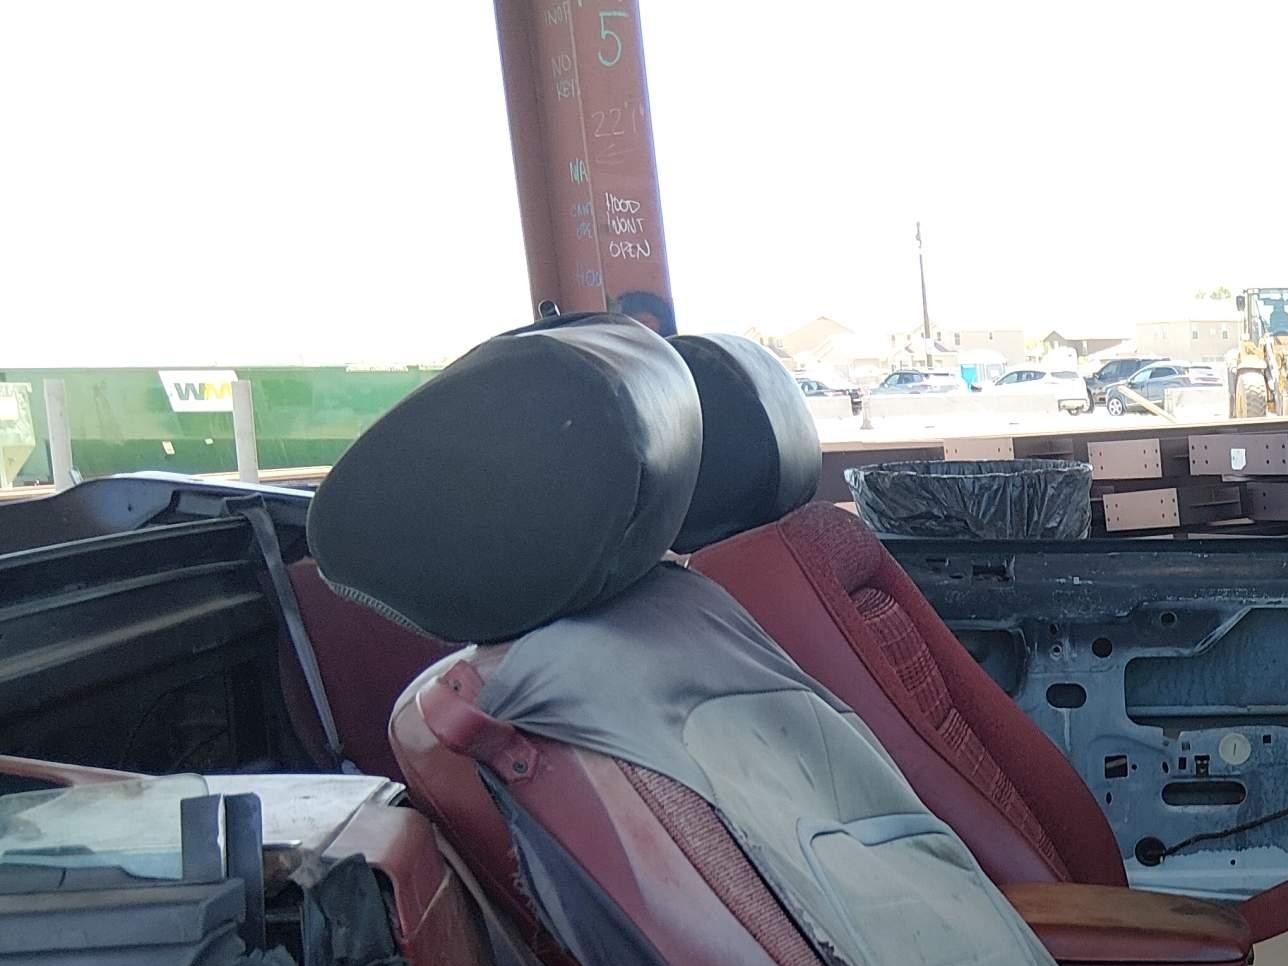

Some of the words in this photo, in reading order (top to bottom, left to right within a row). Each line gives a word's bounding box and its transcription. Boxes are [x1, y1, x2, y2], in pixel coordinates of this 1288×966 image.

[597, 10, 630, 68] 5
[550, 52, 573, 78] NO
[605, 191, 641, 214] HOOD
[609, 239, 651, 260] OPEN
